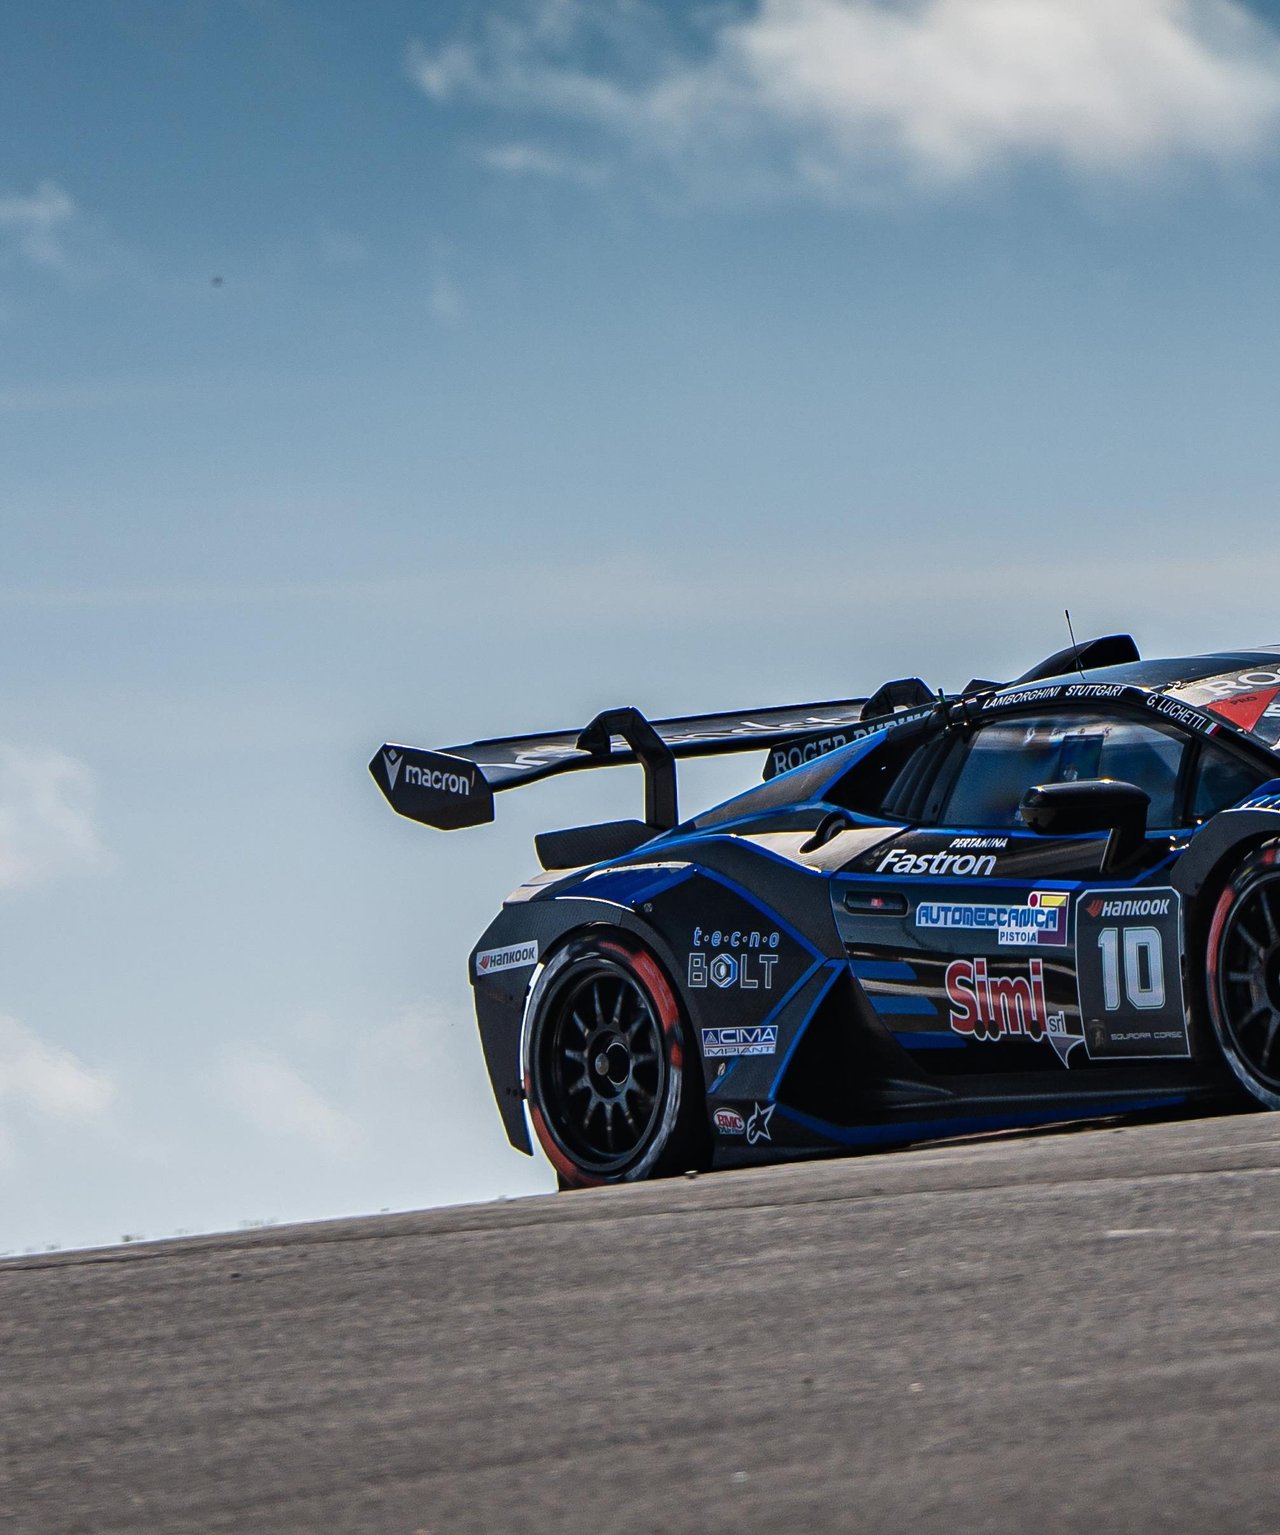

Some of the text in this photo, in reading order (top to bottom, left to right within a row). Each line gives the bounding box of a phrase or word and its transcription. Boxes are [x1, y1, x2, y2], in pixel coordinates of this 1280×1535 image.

[982, 684, 1128, 710] LAMBORGHINI STUTTGART
[1146, 693, 1208, 730] G. LUCHETTI
[405, 765, 470, 796] macron
[950, 837, 1009, 849] PERTAMINA
[875, 848, 998, 876] Fastron
[917, 904, 1058, 929] AUTOMECCANICA
[999, 931, 1037, 943] PISTOIA
[687, 952, 779, 989] BOLT
[1097, 926, 1167, 1012] 10
[944, 957, 1049, 1043] Simi
[720, 1027, 776, 1043] CIMA
[1048, 1011, 1066, 1034] srl
